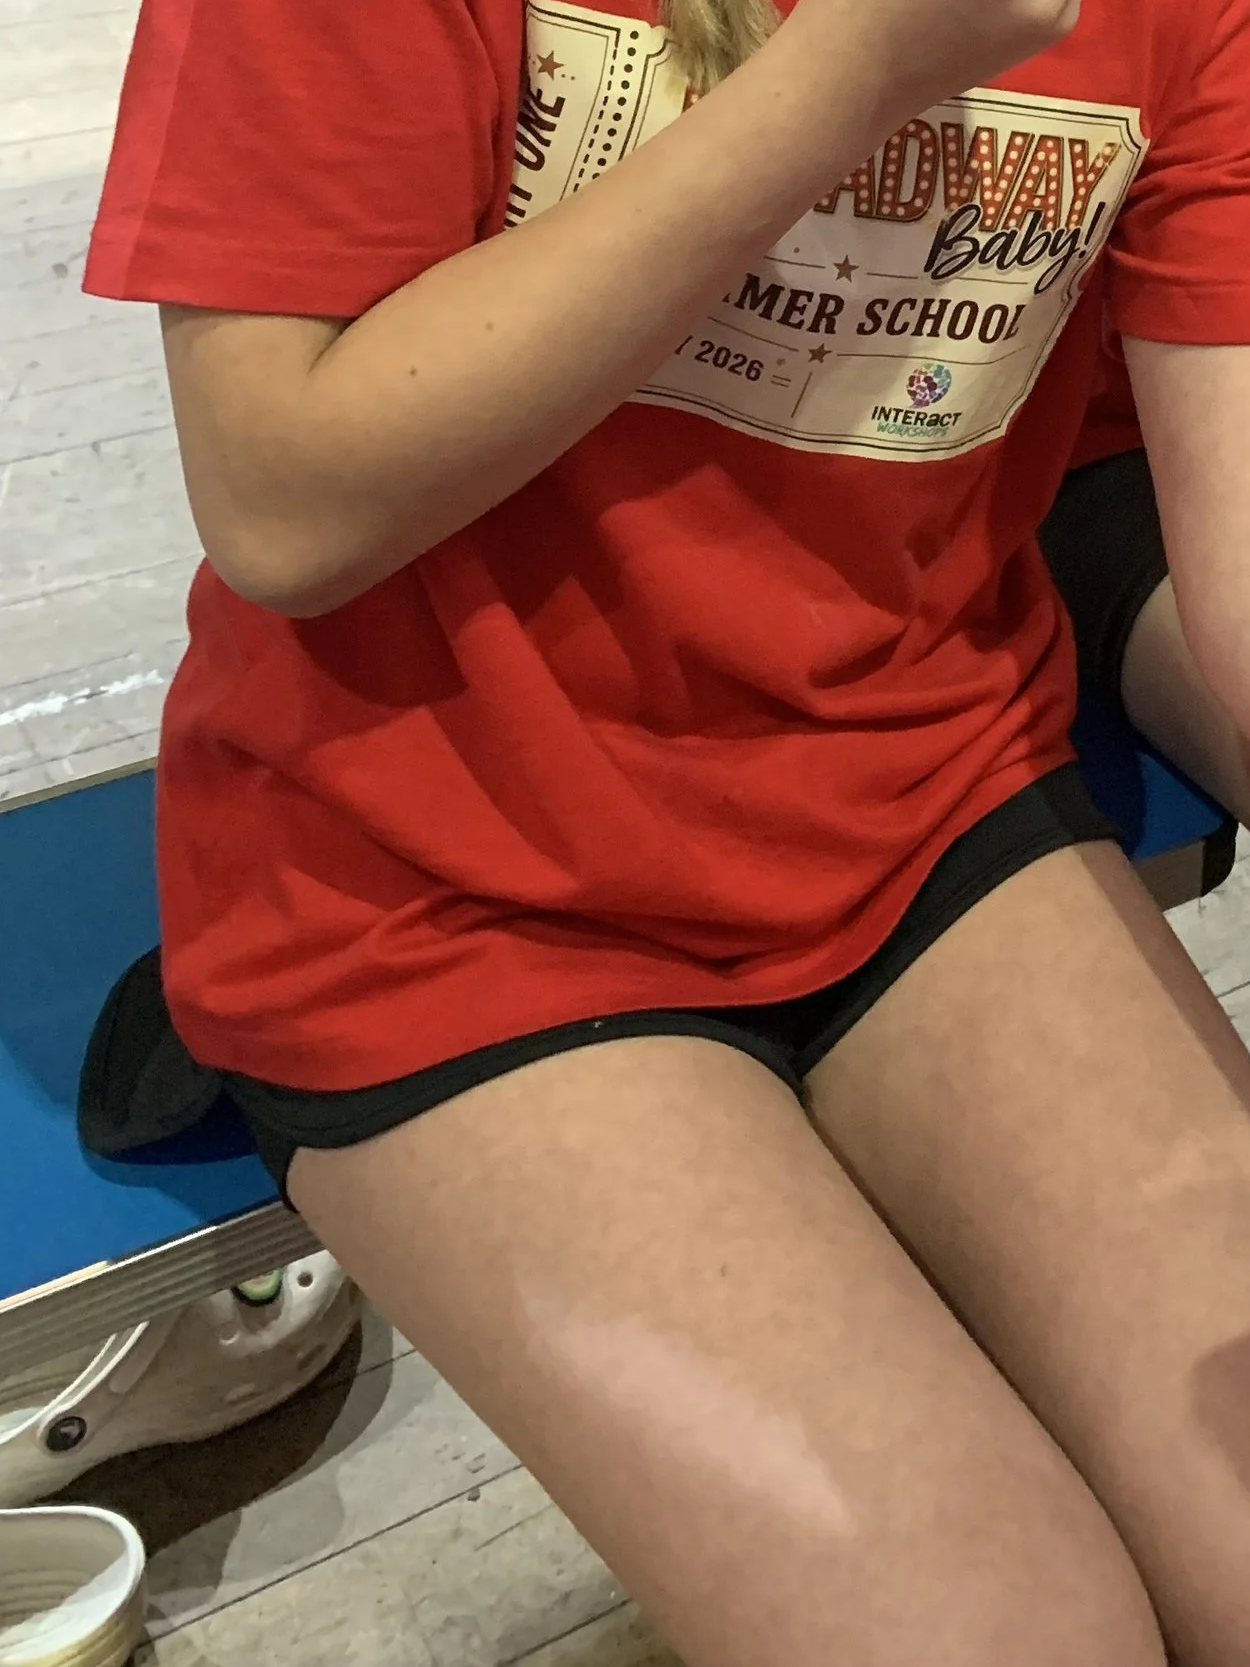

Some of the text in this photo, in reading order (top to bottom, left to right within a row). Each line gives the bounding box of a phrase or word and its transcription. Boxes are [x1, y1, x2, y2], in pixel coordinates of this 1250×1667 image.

[813, 119, 1121, 233] ADWAY
[924, 201, 1106, 296] Baby!
[733, 272, 1027, 345] MER SCHOOL
[694, 340, 764, 382] 2026
